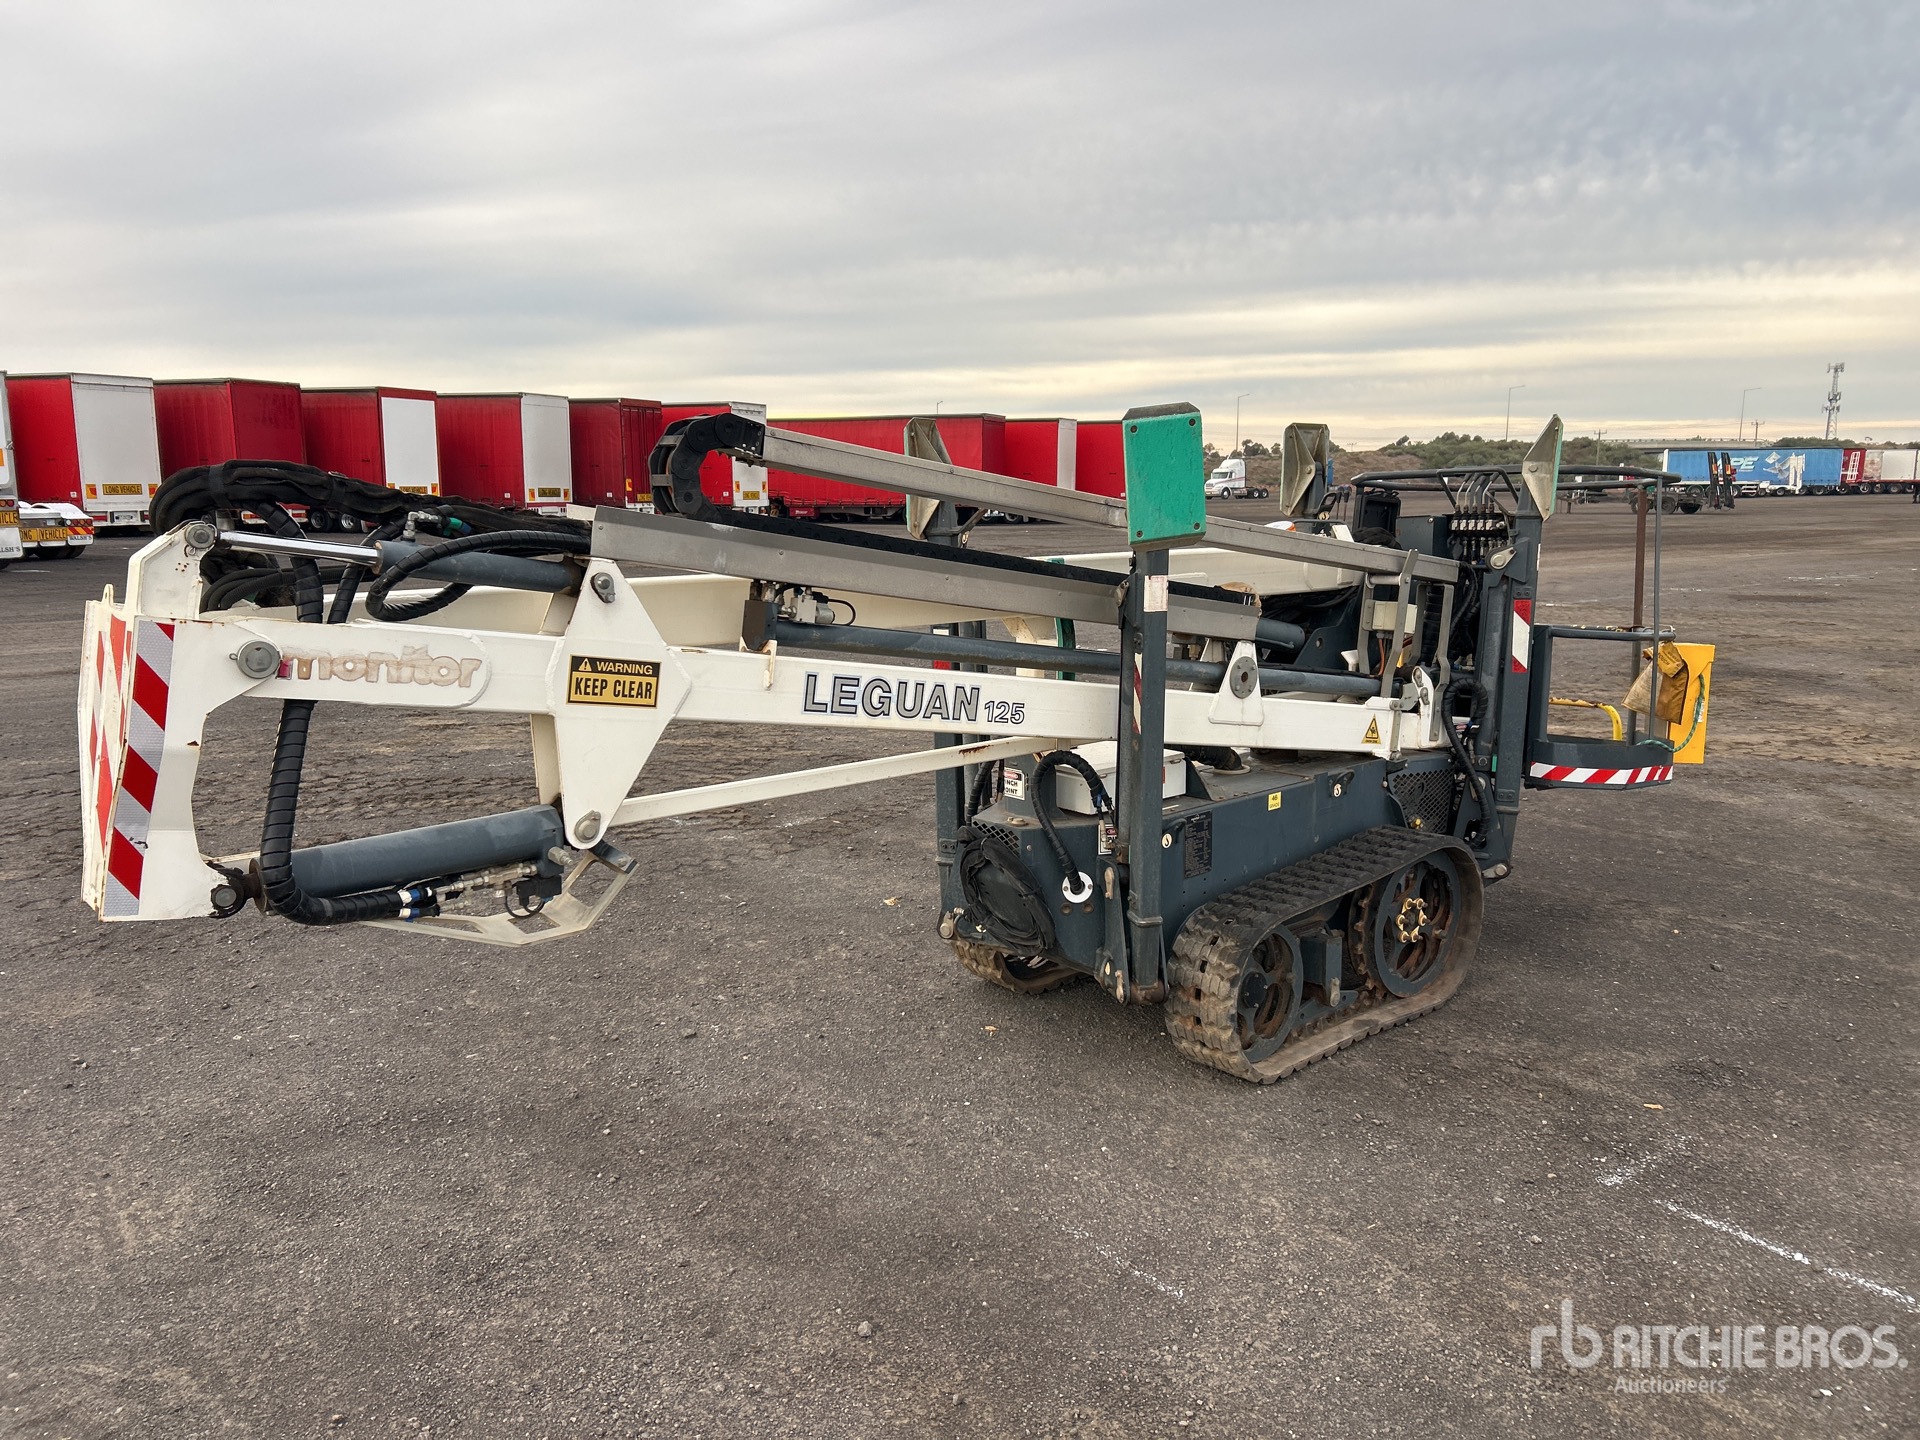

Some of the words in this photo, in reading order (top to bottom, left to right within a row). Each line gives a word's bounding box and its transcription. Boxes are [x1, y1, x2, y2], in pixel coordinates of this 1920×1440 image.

[104, 485, 119, 494] LONG
[120, 485, 141, 494] VEHICLE
[40, 529, 66, 540] VEHICLE
[277, 645, 482, 688] monitor
[596, 661, 653, 675] WARNING
[574, 677, 608, 696] KEEP
[613, 679, 652, 699] CLEAR
[804, 673, 980, 721] LEGUAN
[984, 700, 1025, 725] 125
